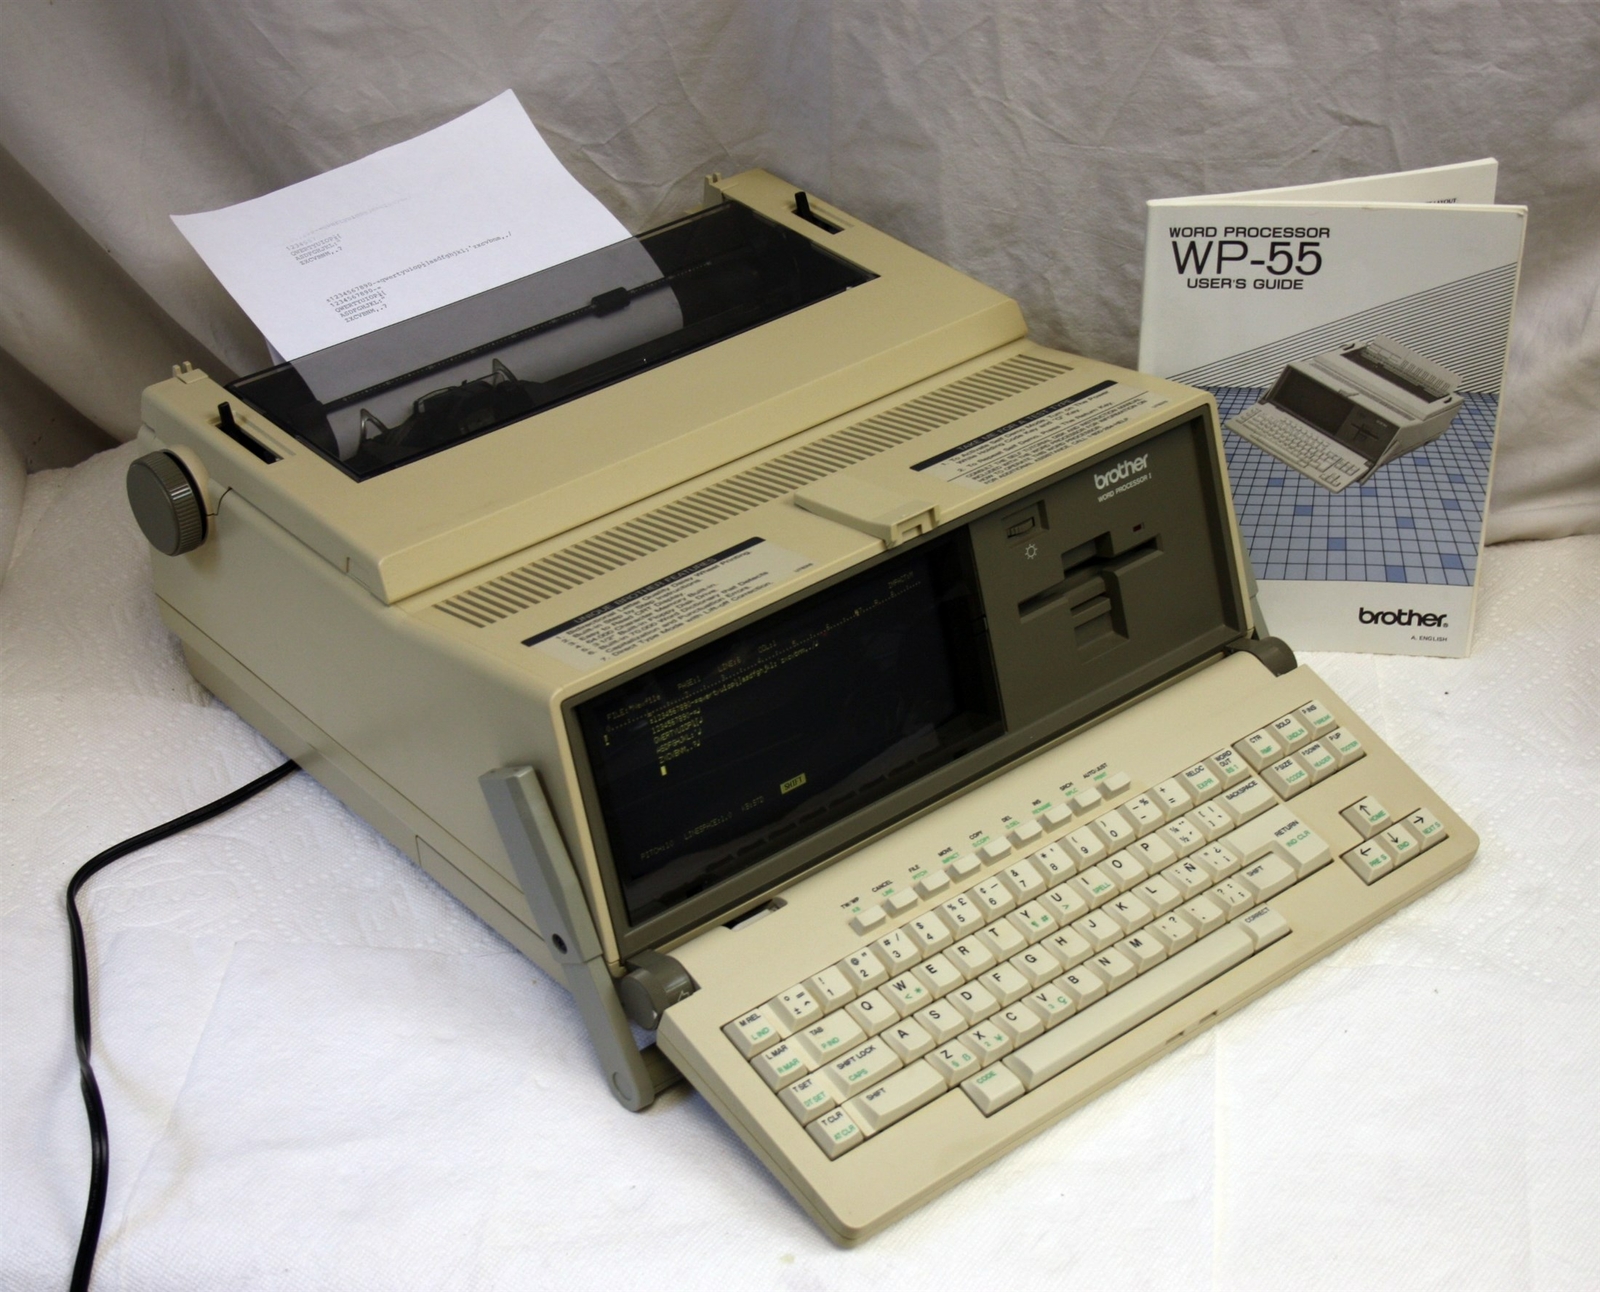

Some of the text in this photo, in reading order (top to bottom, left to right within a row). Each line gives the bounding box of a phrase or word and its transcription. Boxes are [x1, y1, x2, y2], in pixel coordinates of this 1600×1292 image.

[1169, 226, 1330, 239] WORD PROCESSOR
[1171, 240, 1323, 276] WP-55
[1186, 277, 1304, 290] USER'S GUIDE
[1085, 389, 1110, 400] Power
[956, 439, 983, 451] TAKE
[980, 432, 999, 440] ME
[995, 423, 1019, 433] FOR
[1024, 409, 1051, 420] TEST
[1048, 398, 1075, 409] TYPE
[1094, 453, 1148, 490] brother
[1097, 474, 1148, 503] WORD PROCESSOR
[571, 557, 718, 623] UNIQUE BROTHER FEATURES
[1358, 606, 1448, 628] brother
[1275, 718, 1291, 730] BOLD
[1249, 734, 1262, 744] CTR
[1214, 750, 1232, 762] WORD
[1219, 758, 1232, 767] OUT
[1185, 765, 1205, 778] RELOC
[784, 776, 804, 791] SHIFT
[1226, 780, 1258, 800] BACKSPACE
[1274, 820, 1299, 837] RETURN
[969, 830, 983, 840] COPY
[1110, 830, 1118, 838] 0
[1297, 830, 1311, 840] CLR
[1081, 846, 1089, 854] 9
[1140, 842, 1150, 851] P
[908, 864, 920, 873] FILE
[1050, 863, 1058, 871] 8
[1112, 859, 1122, 869] O
[1247, 865, 1264, 877] SHIFT
[871, 880, 893, 893] CANCEL
[1019, 880, 1028, 888] 7
[1081, 877, 1090, 886] I
[1092, 882, 1111, 894] SPELL
[1146, 886, 1157, 895] L
[989, 897, 997, 906] 6
[1051, 893, 1063, 902] U
[1117, 901, 1128, 911] K
[957, 914, 965, 922] 5
[1020, 910, 1031, 919] Y
[1244, 906, 1270, 924] CORRECT
[1089, 919, 1097, 928] J
[926, 933, 933, 941] 4
[988, 928, 999, 938] T
[1055, 936, 1067, 947] H
[1130, 938, 1143, 948] M
[892, 950, 901, 958] 3
[958, 945, 970, 956] R
[1024, 954, 1037, 963] G
[1098, 957, 1111, 967] N
[860, 969, 869, 978] 2
[925, 964, 938, 974] E
[992, 972, 1002, 982] F
[1068, 975, 1079, 984] B
[892, 980, 907, 991] W
[960, 991, 972, 1001] D
[1036, 993, 1047, 1002] V
[860, 1001, 873, 1011] Q
[746, 1013, 761, 1024] REL
[929, 1010, 941, 1020] S
[1006, 1012, 1017, 1021] C
[809, 1027, 824, 1036] TAB
[897, 1029, 909, 1039] A
[973, 1031, 986, 1040] X
[771, 1044, 788, 1057] MAR
[940, 1050, 953, 1060] Z
[837, 1045, 876, 1070] SHIFT LOCK
[848, 1068, 868, 1081] CAPS
[976, 1070, 997, 1084] CODE
[798, 1079, 812, 1090] SET
[866, 1087, 886, 1101] SHIFT
[827, 1111, 843, 1123] CLR
